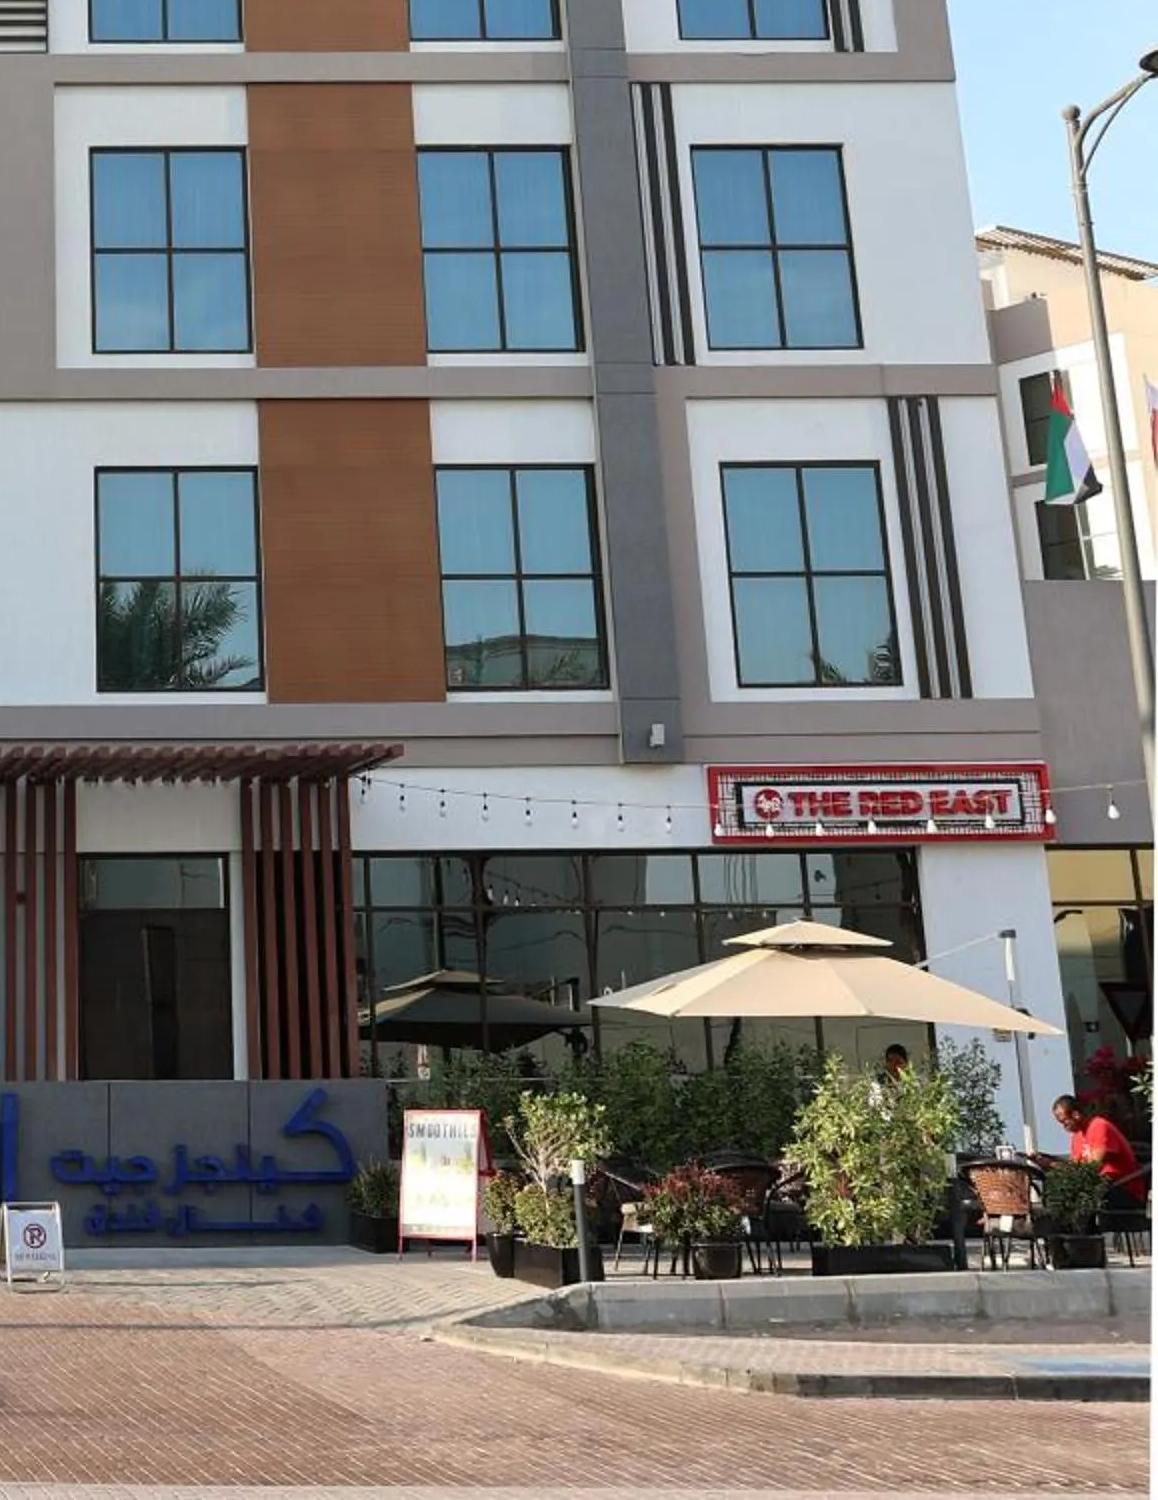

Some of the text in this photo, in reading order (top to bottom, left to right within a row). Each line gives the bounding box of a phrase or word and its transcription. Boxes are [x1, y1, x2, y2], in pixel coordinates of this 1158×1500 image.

[790, 789, 1013, 817] THE RED EAST
